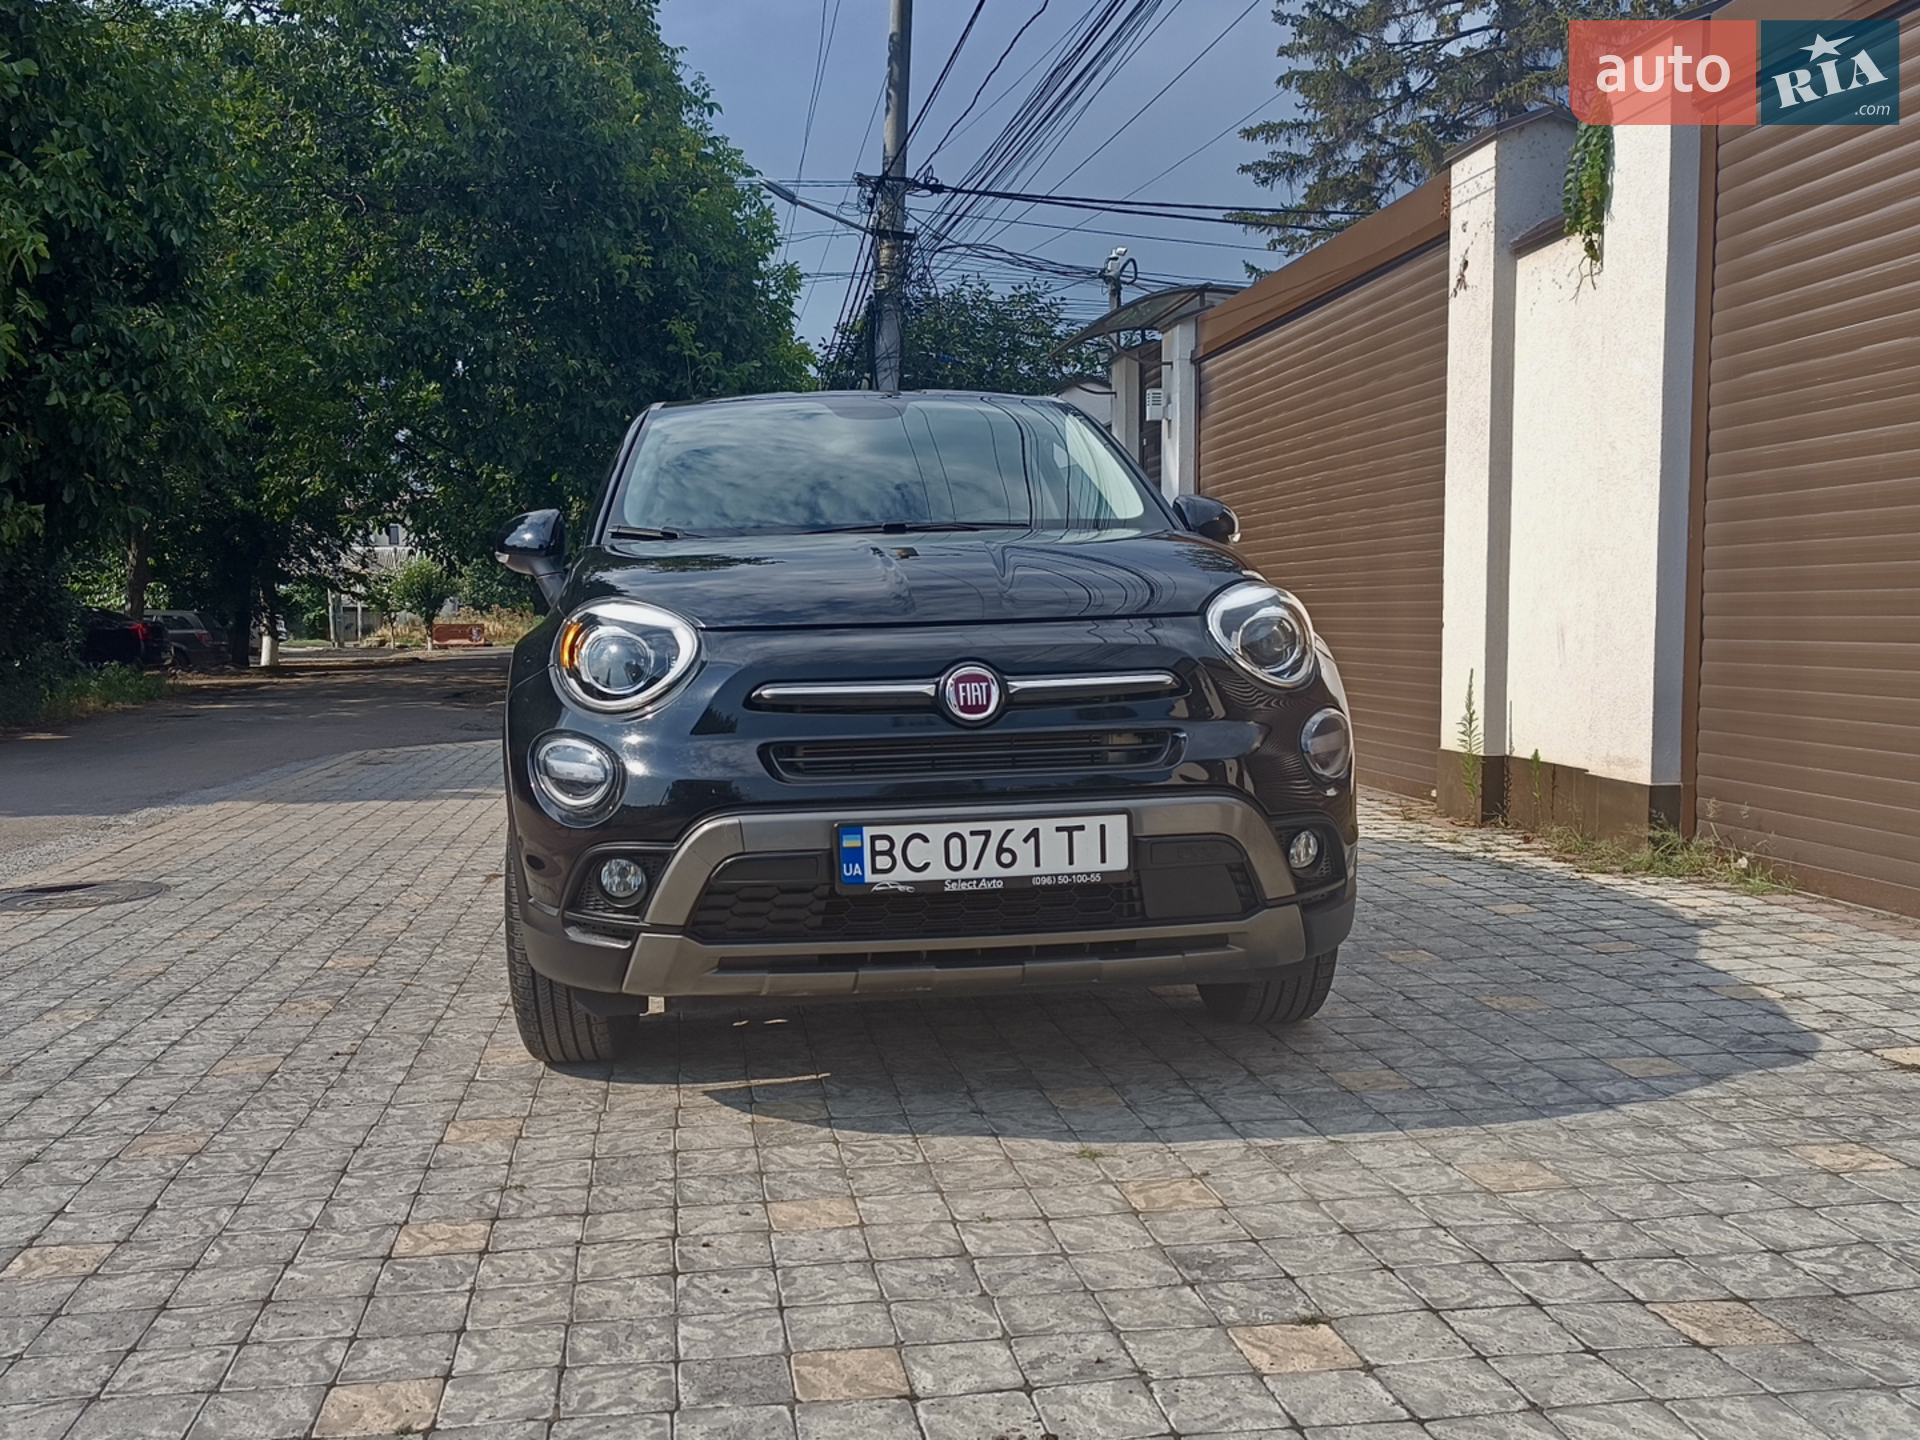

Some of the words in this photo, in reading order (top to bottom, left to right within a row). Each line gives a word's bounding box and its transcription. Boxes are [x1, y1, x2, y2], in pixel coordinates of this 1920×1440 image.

[958, 682, 988, 706] FIAT
[843, 863, 862, 876] UA
[944, 879, 977, 891] Select
